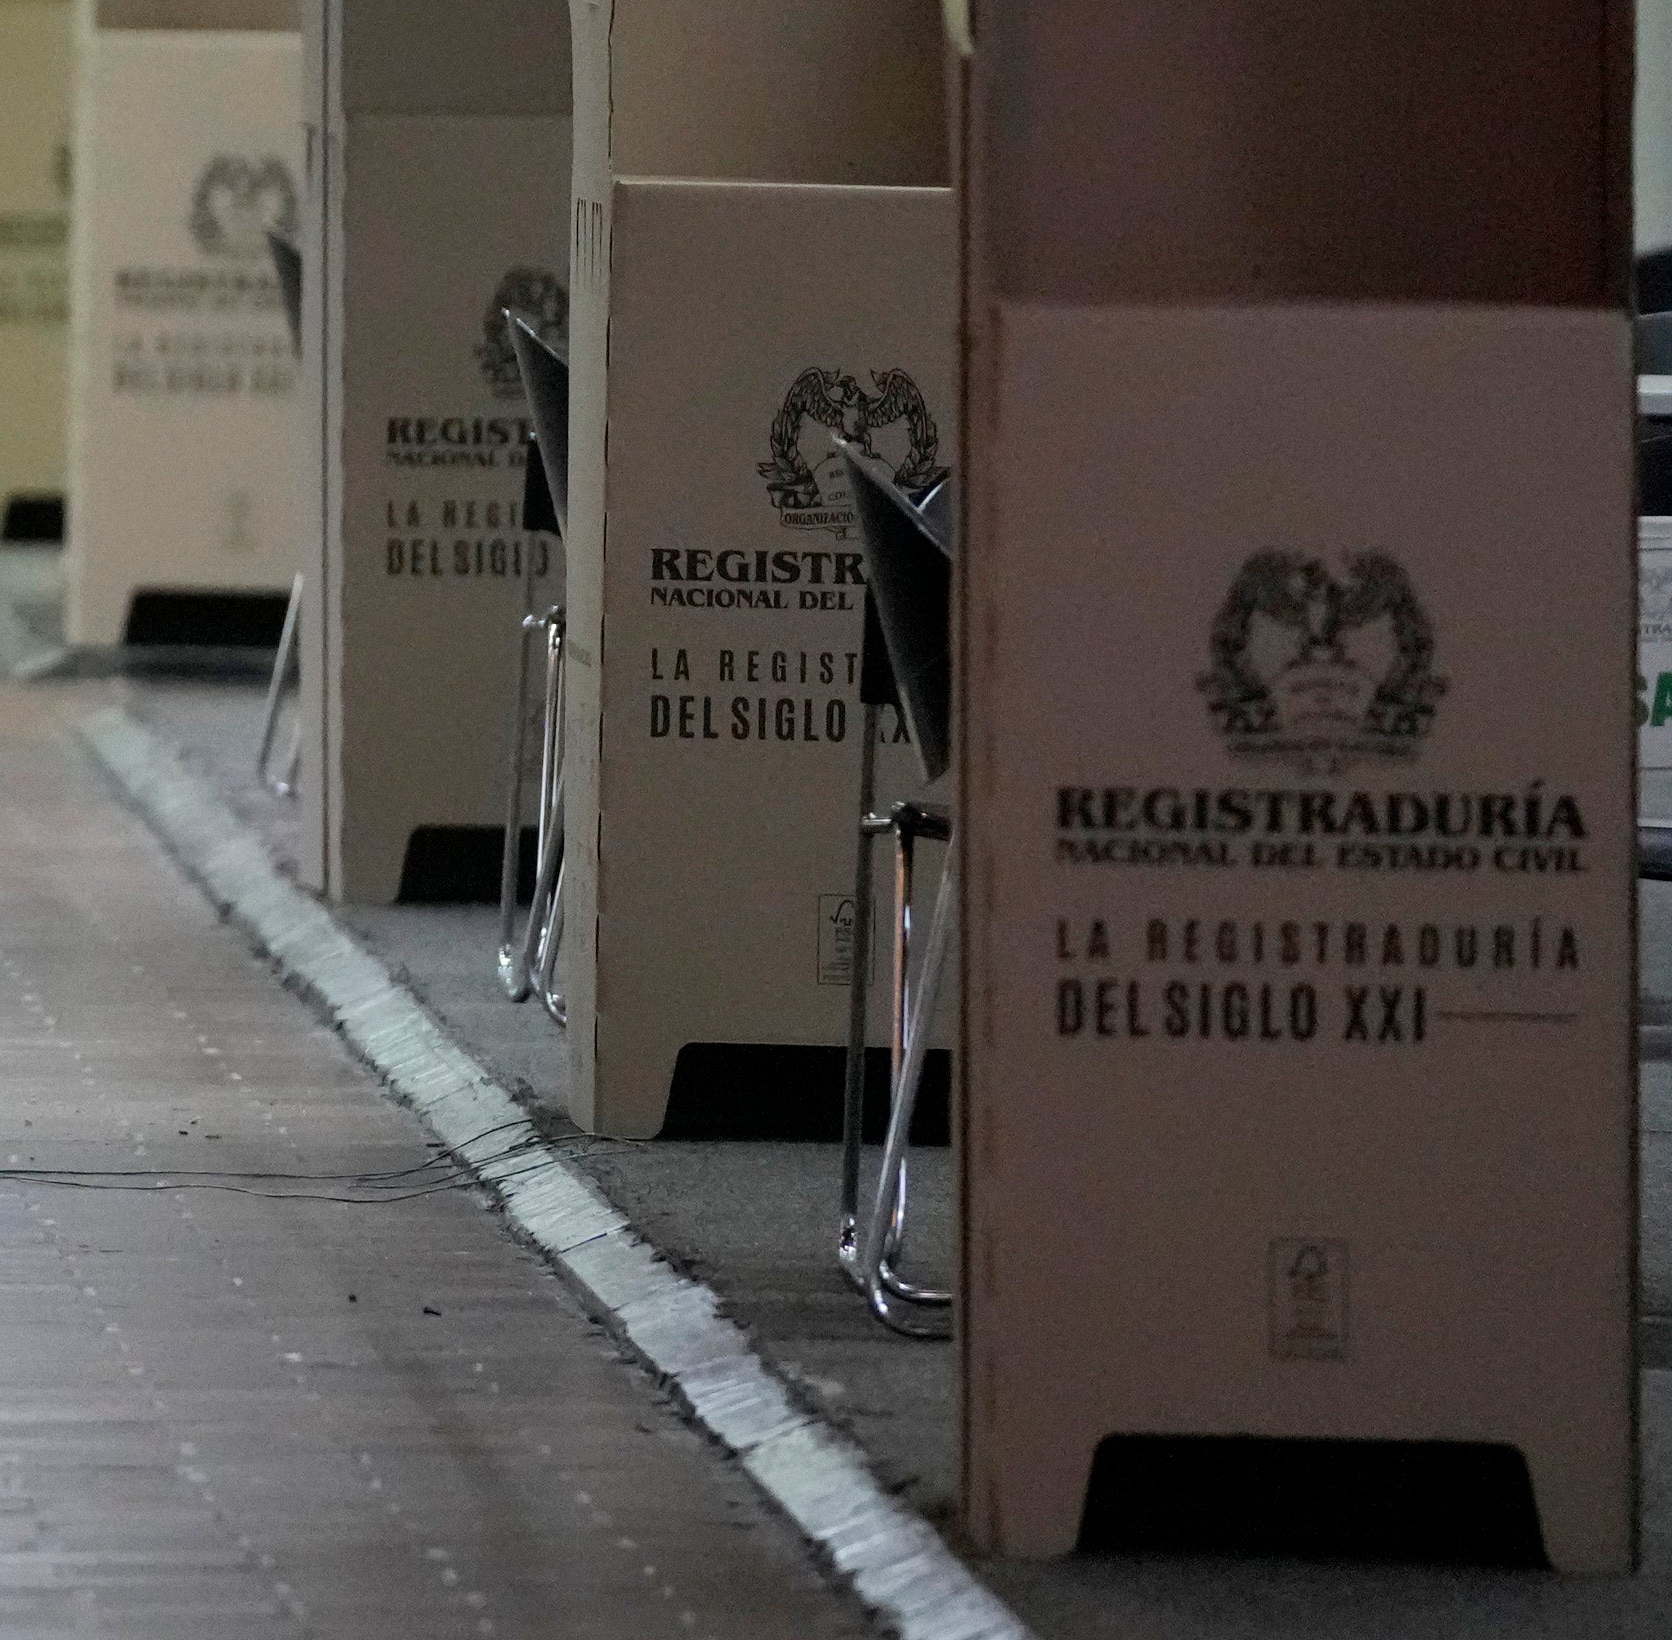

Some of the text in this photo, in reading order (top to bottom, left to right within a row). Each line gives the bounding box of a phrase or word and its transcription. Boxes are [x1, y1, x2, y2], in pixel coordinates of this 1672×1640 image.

[386, 498, 421, 529] LA
[386, 536, 443, 578] DEL
[650, 587, 854, 611] NACIONAL DEL
[651, 648, 858, 684] LA REGIST
[650, 694, 719, 740] DEL
[731, 696, 847, 743] SIGLO
[1056, 777, 1590, 840] REGISTRADURÍA
[1252, 841, 1316, 868] DEL
[1493, 844, 1588, 875] CIVIL
[1057, 915, 1581, 971] LA REGISTRADURÍA
[1057, 978, 1428, 1044] DEL SIGLO XXI
